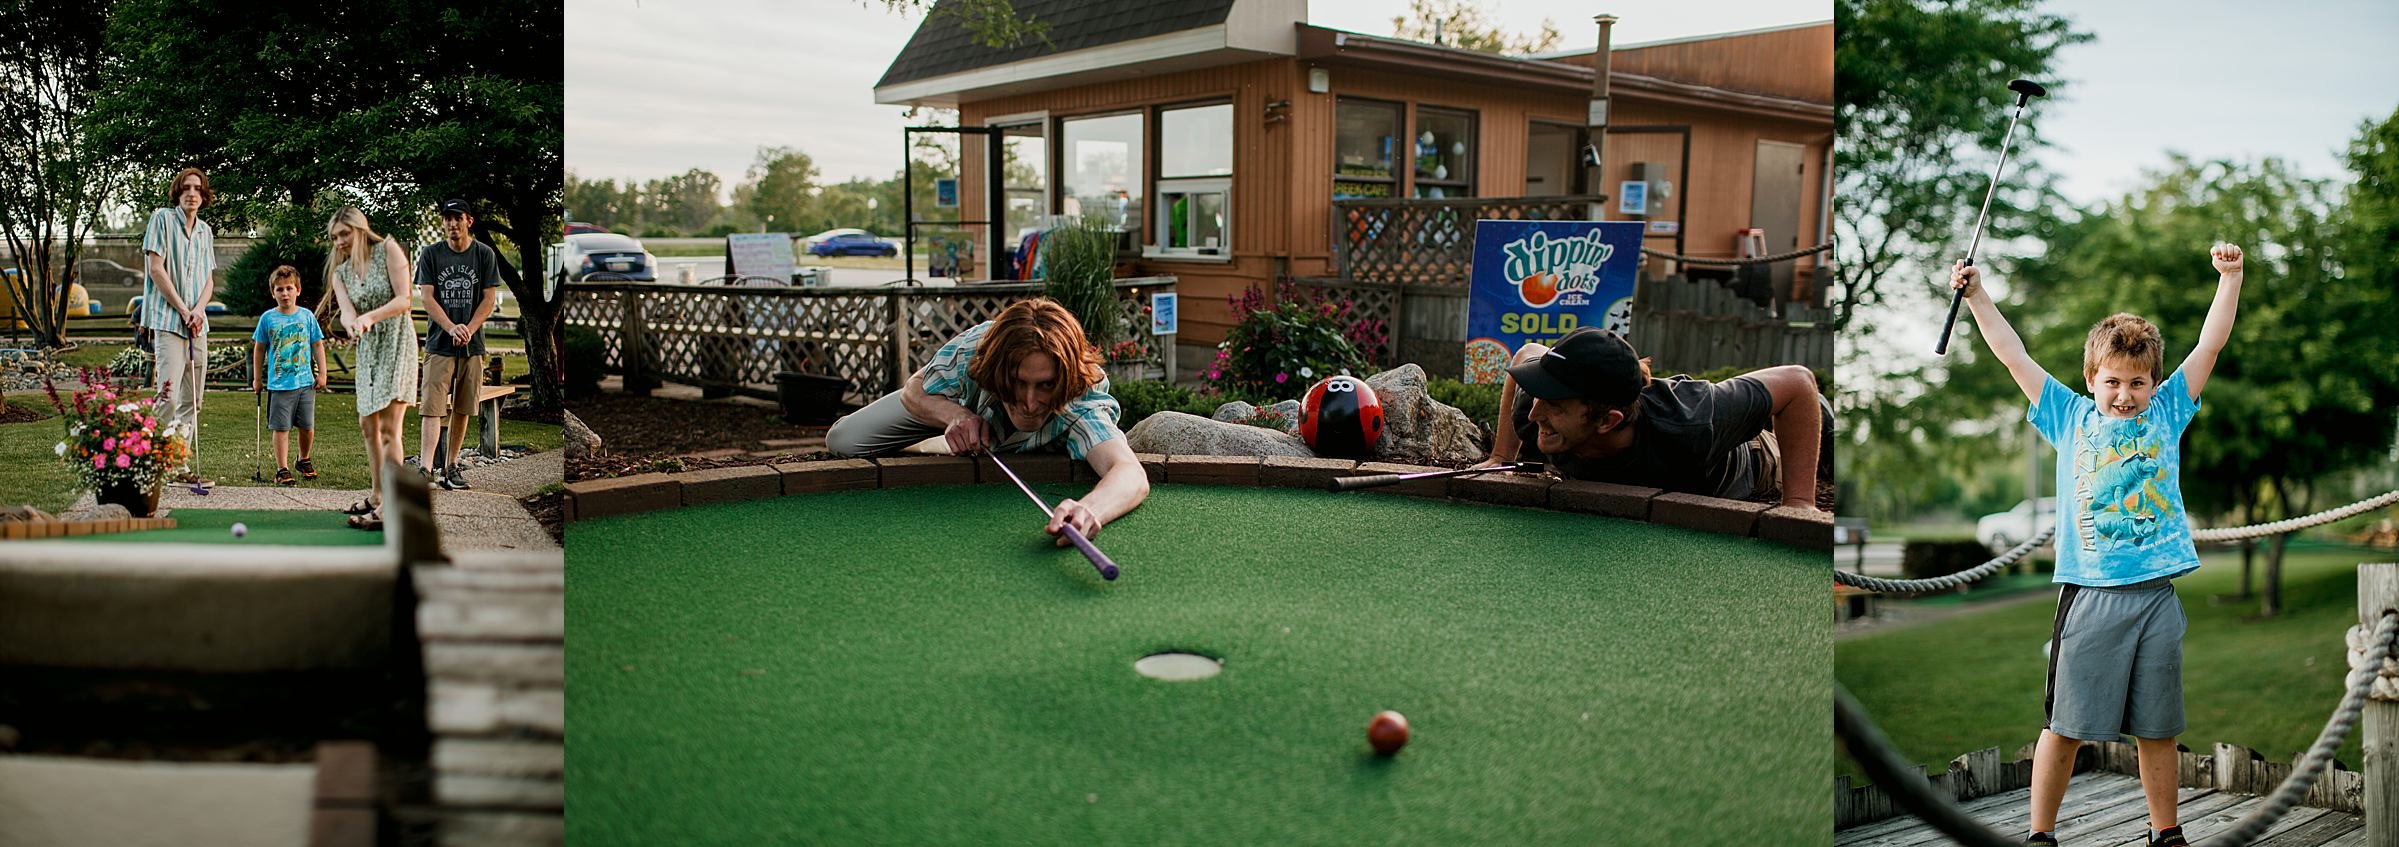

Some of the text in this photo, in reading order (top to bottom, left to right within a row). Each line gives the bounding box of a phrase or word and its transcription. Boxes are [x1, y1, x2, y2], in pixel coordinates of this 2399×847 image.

[1505, 229, 1613, 284] dippin'
[438, 265, 478, 286] CONEY ISLAND
[1556, 271, 1599, 294] dots
[441, 290, 471, 299] NEW YOR
[1501, 312, 1578, 334] SOLD
